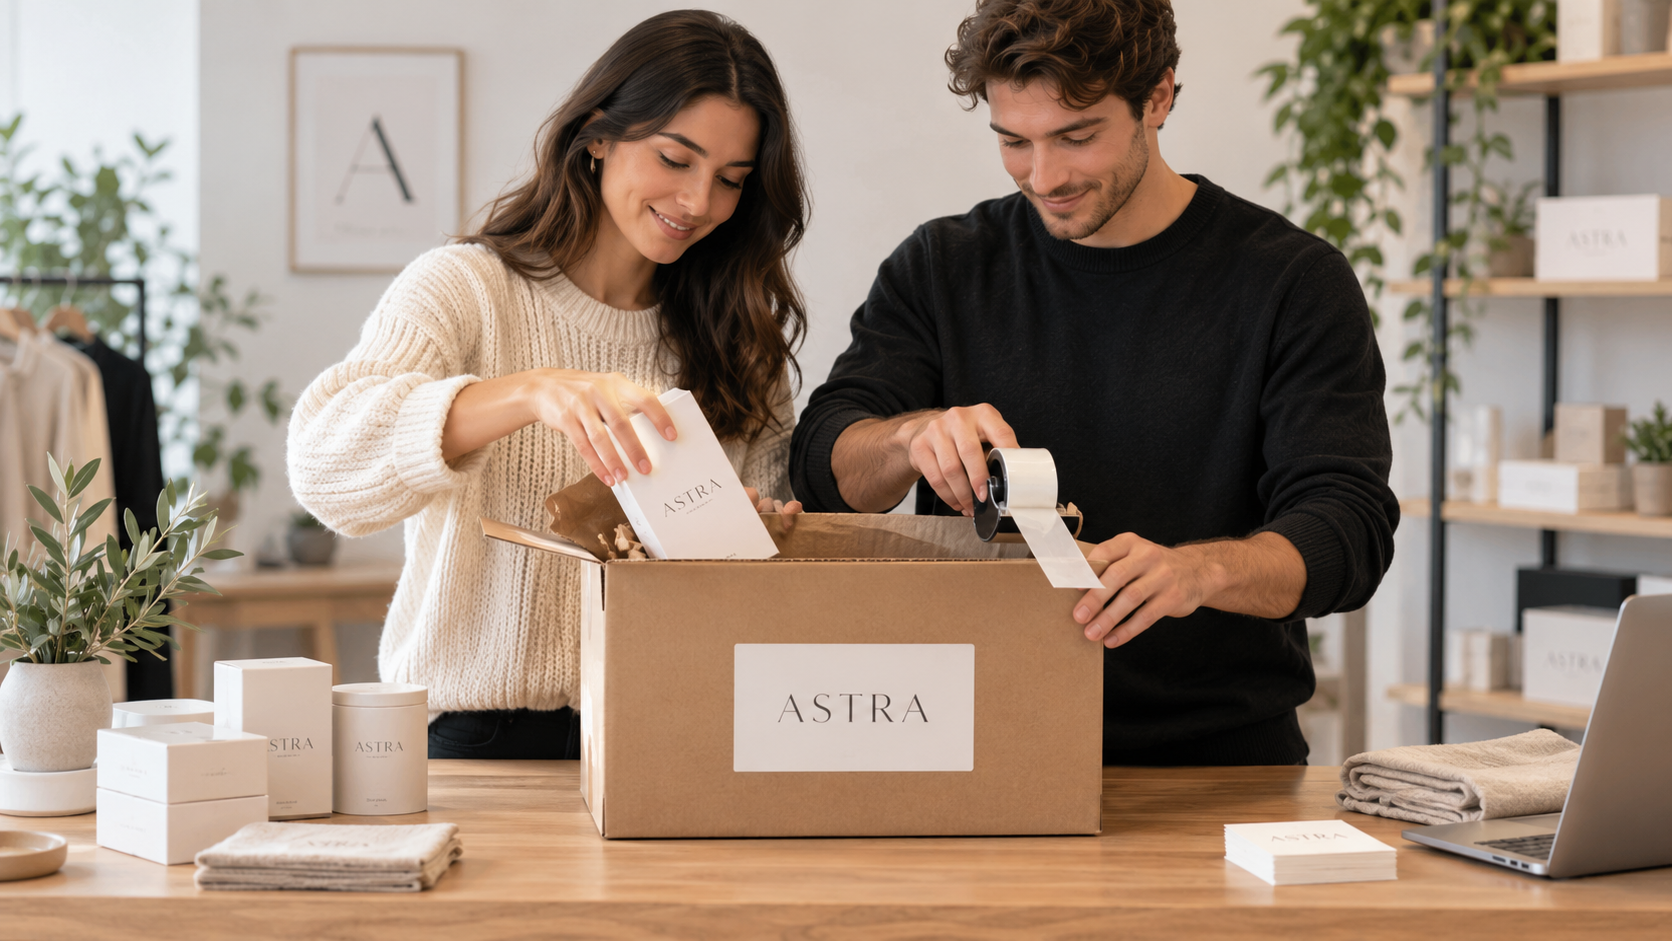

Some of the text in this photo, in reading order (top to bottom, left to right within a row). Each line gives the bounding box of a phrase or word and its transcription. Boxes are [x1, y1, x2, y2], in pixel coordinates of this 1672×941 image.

[335, 116, 416, 204] A
[1565, 230, 1628, 250] ASTRA
[663, 478, 723, 518] ASTRA
[777, 692, 930, 724] ASTRA
[267, 737, 315, 752] STRA
[354, 740, 404, 753] ASTRA
[1271, 832, 1348, 843] ASTRA
